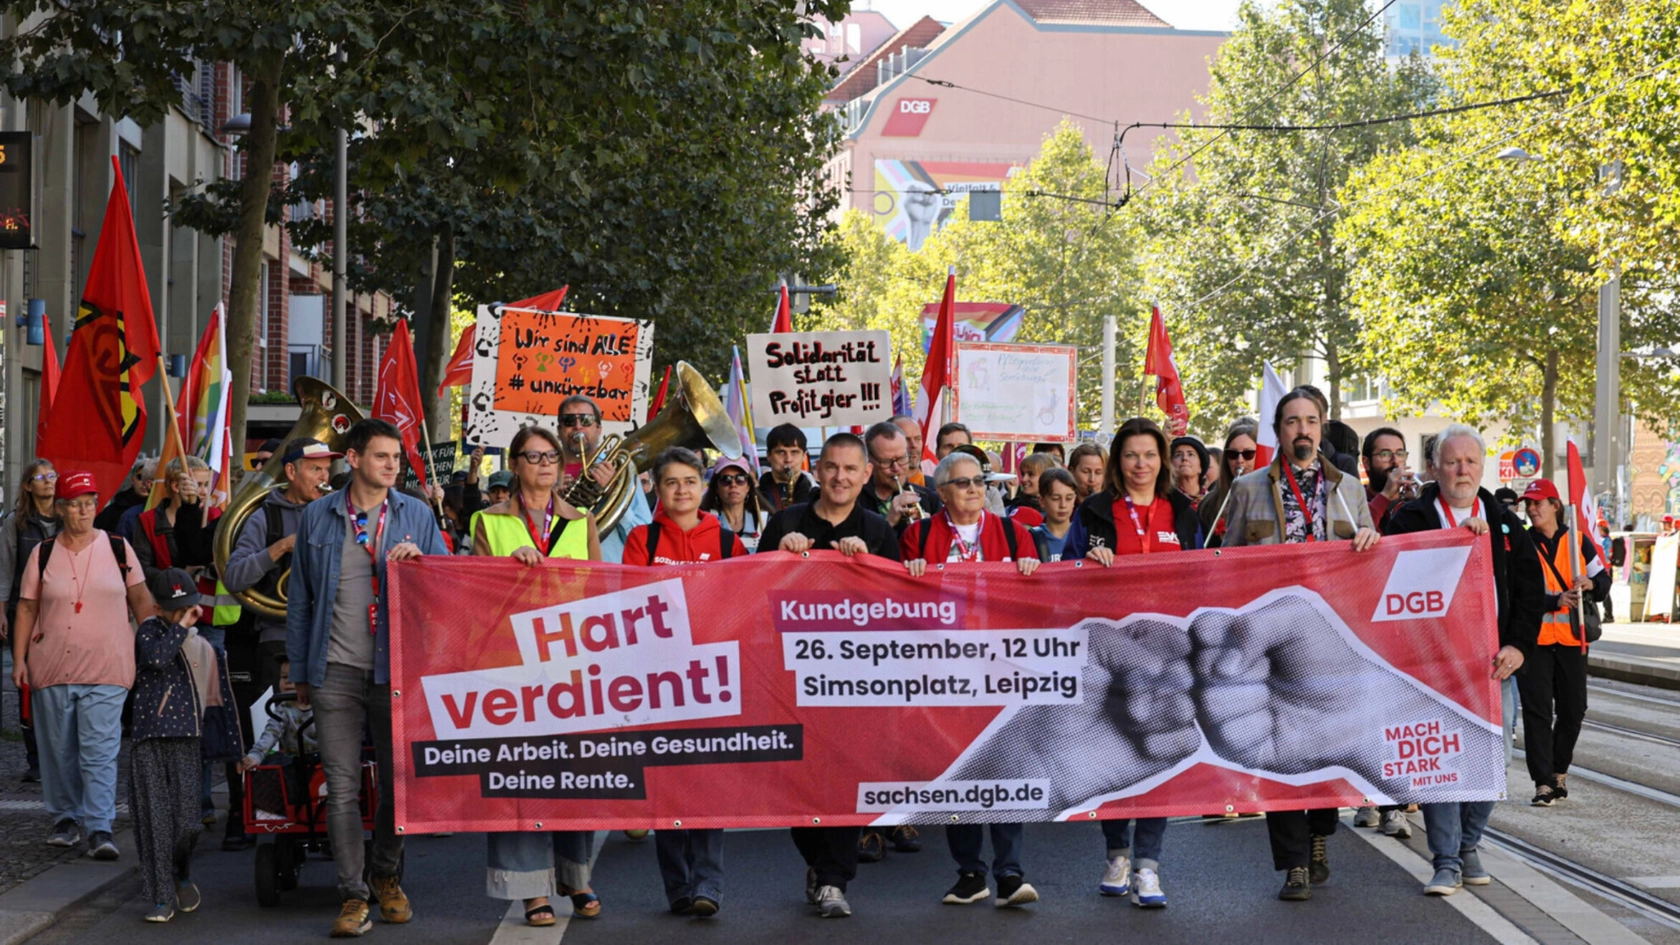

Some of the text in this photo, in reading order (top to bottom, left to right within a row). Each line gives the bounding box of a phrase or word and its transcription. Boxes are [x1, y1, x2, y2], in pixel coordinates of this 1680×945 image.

[901, 101, 930, 113] DGB
[515, 327, 632, 356] Wir sind ALLE
[765, 341, 881, 369] Solidarität
[793, 364, 848, 385] statt
[530, 377, 629, 400] unkürzbar
[768, 388, 858, 420] Profitgier
[859, 382, 881, 411] !!!
[438, 446, 456, 458] FÜR
[780, 598, 956, 625] Kundgebung
[1386, 591, 1444, 615] DGB
[532, 595, 673, 662] Hart
[795, 637, 1080, 666] 26. September, 12 Uhr
[441, 656, 732, 730] verdient!
[803, 671, 1077, 701] Simsonplatz, Leipzig
[1385, 721, 1440, 741] MACH
[424, 730, 794, 764] Deine Arbeit. Deine Gesundheit.
[1398, 733, 1460, 759] DICH
[1384, 757, 1441, 777] STARK
[489, 770, 635, 790] Deine Rente.
[1413, 773, 1458, 787] MIT UNS
[864, 784, 1044, 808] sachsen.dgb.de
